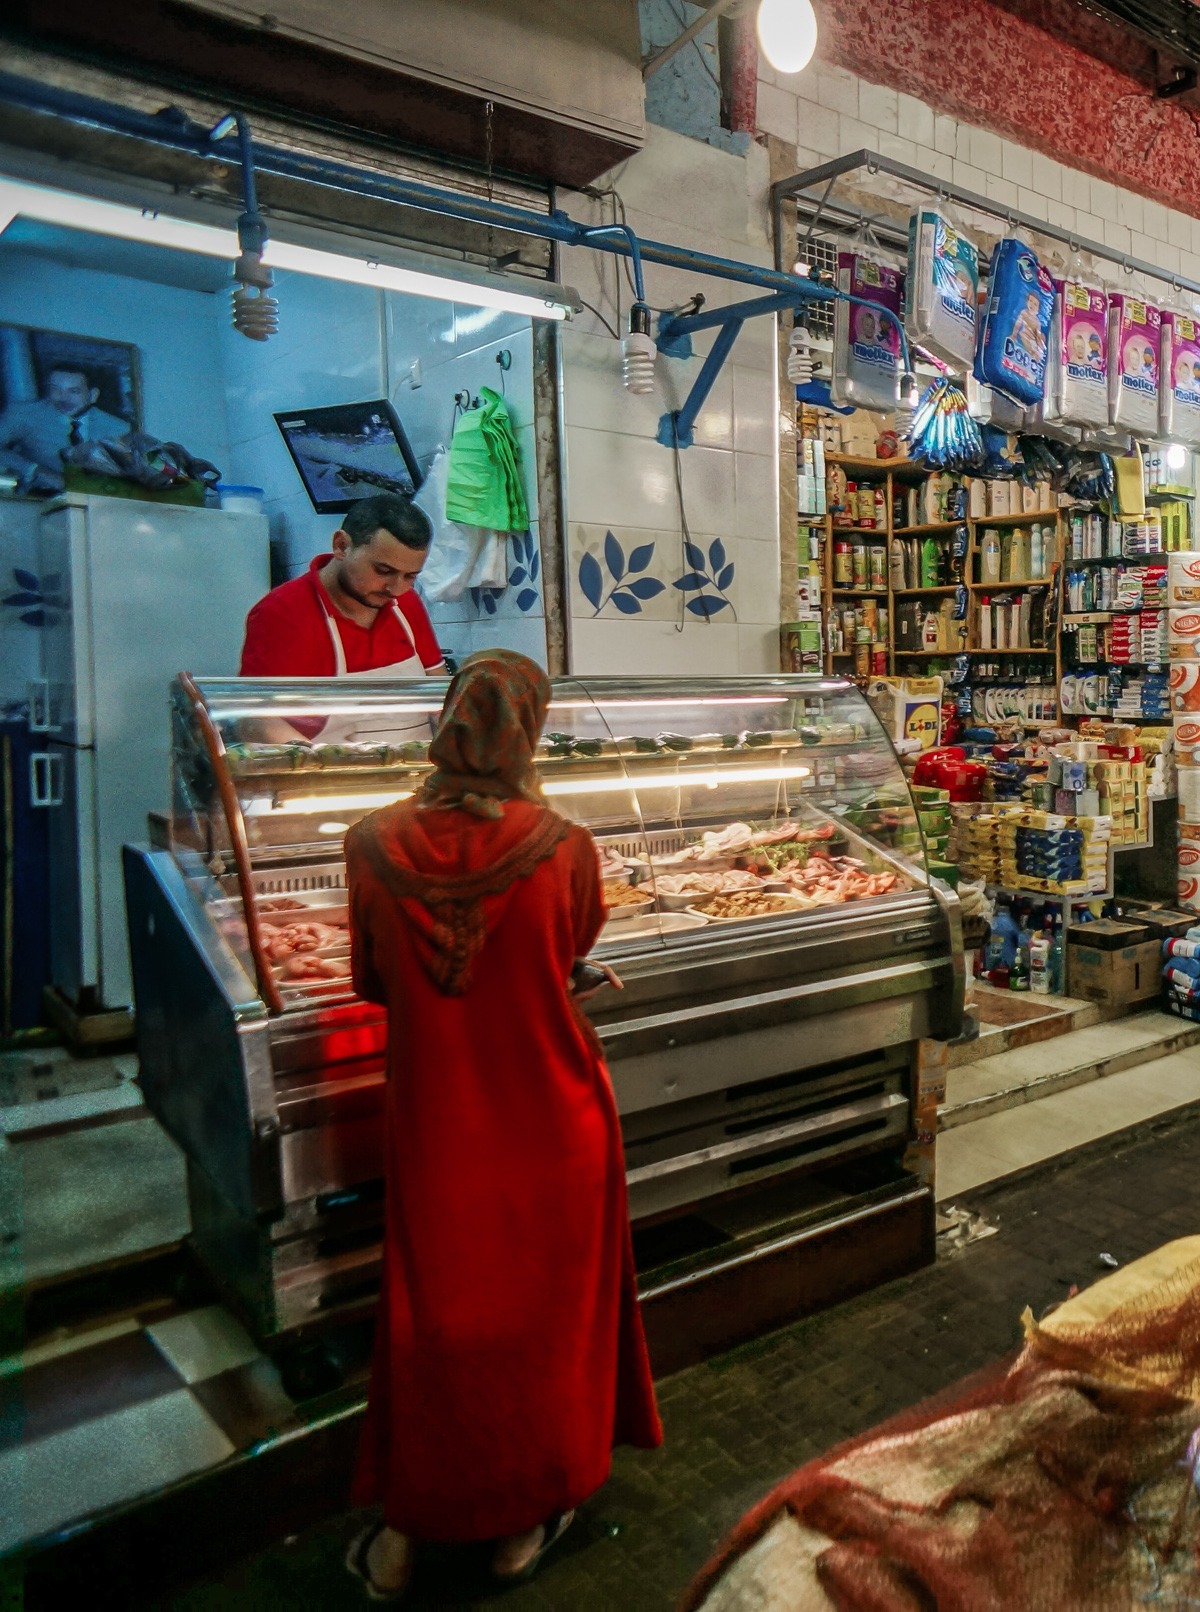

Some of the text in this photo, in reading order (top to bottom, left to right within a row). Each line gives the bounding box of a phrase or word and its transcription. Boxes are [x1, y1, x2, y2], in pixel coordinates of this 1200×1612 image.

[855, 343, 894, 364] moltex
[1068, 364, 1103, 381] moltex
[1123, 376, 1155, 392] moltex
